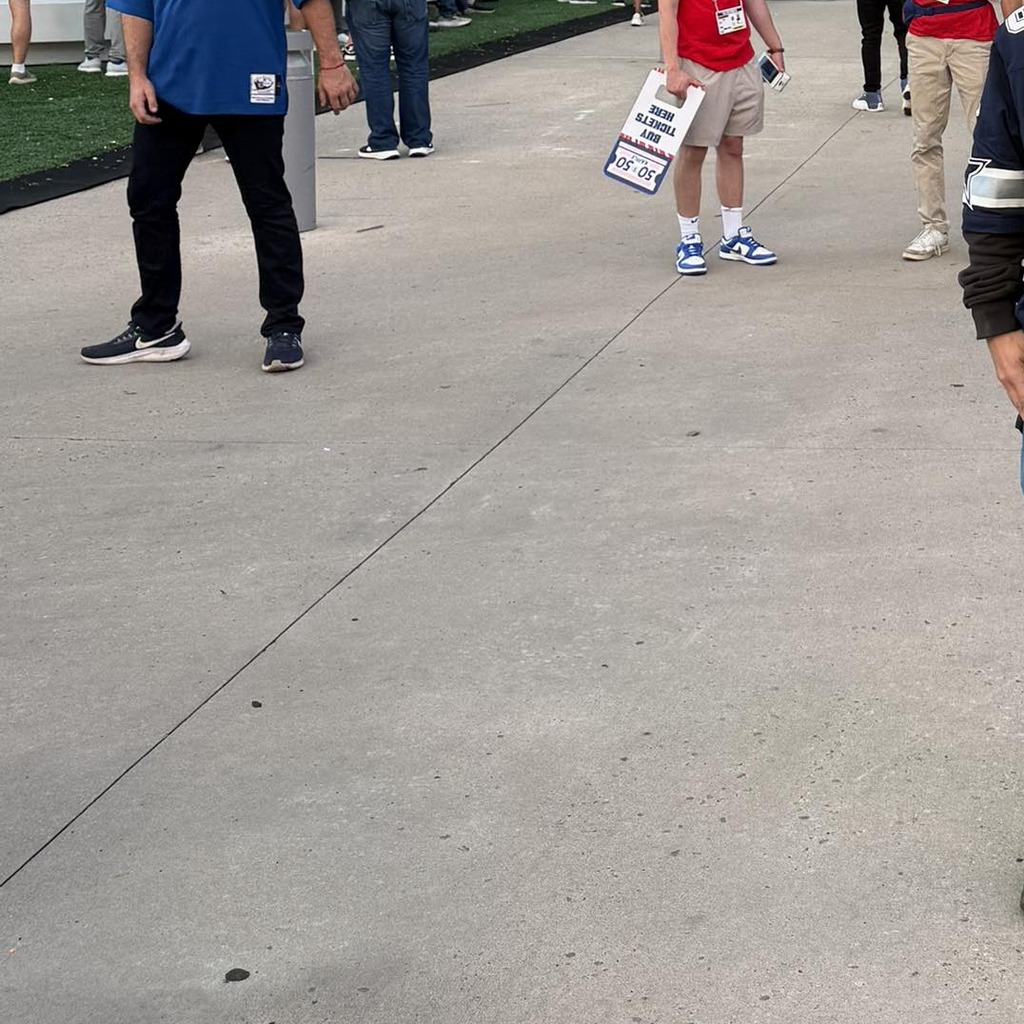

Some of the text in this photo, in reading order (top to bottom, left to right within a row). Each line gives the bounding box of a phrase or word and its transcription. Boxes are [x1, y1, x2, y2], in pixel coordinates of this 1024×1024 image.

[648, 104, 675, 122] HERE
[635, 112, 677, 137] TICKETS
[640, 129, 661, 144] BUY
[616, 156, 656, 180] 50 50
